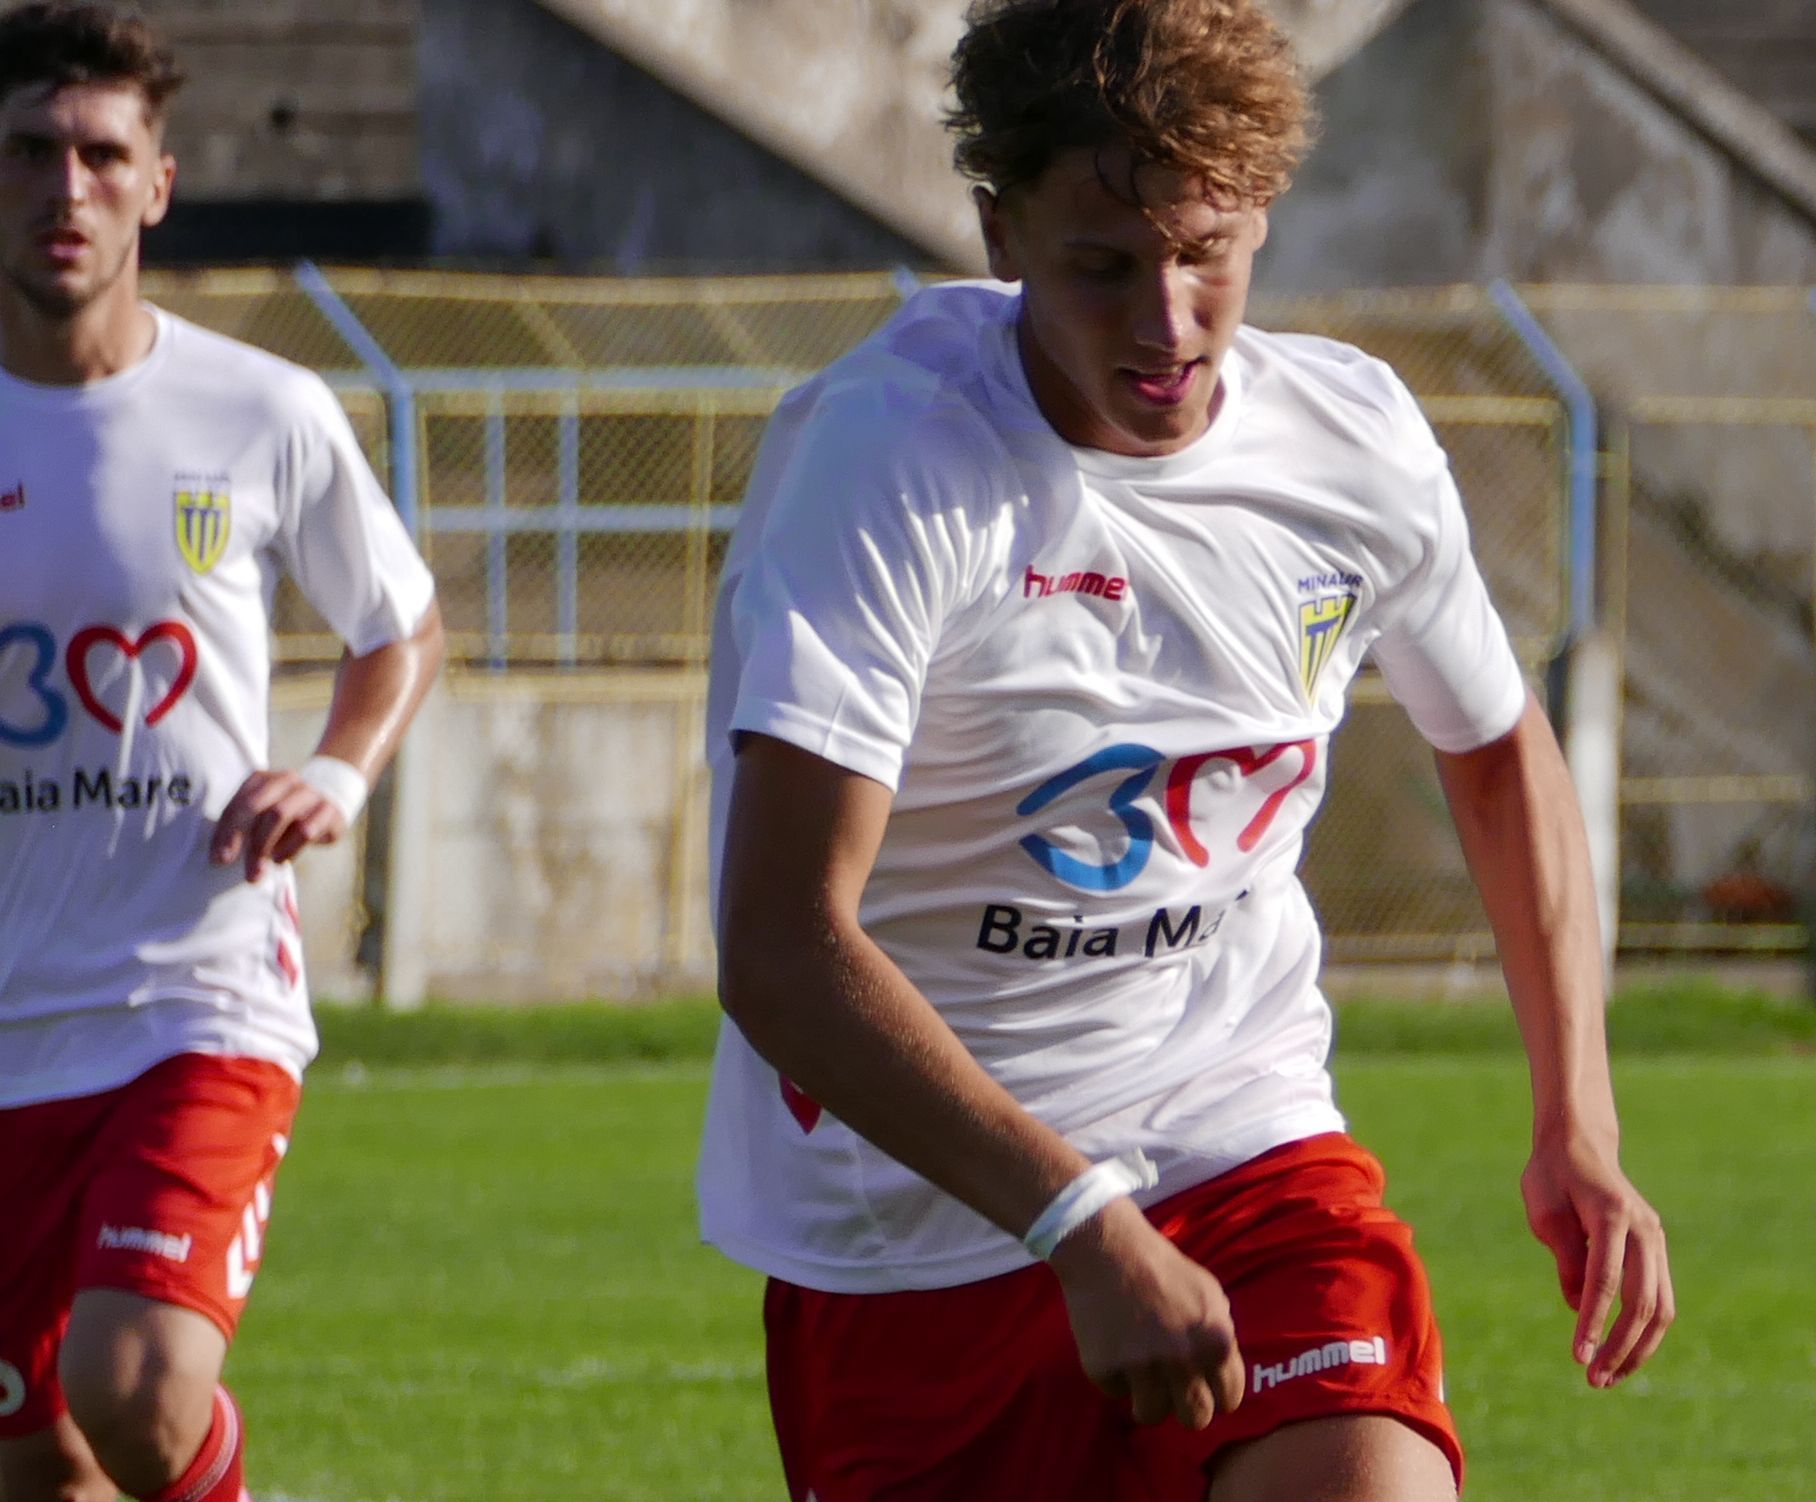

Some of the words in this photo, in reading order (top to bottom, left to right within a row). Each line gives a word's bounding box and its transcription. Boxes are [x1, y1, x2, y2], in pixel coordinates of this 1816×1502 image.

[1023, 564, 1128, 602] humme
[0, 767, 60, 814] aia
[976, 904, 1120, 960] Baia
[1252, 1335, 1387, 1394] hummel
